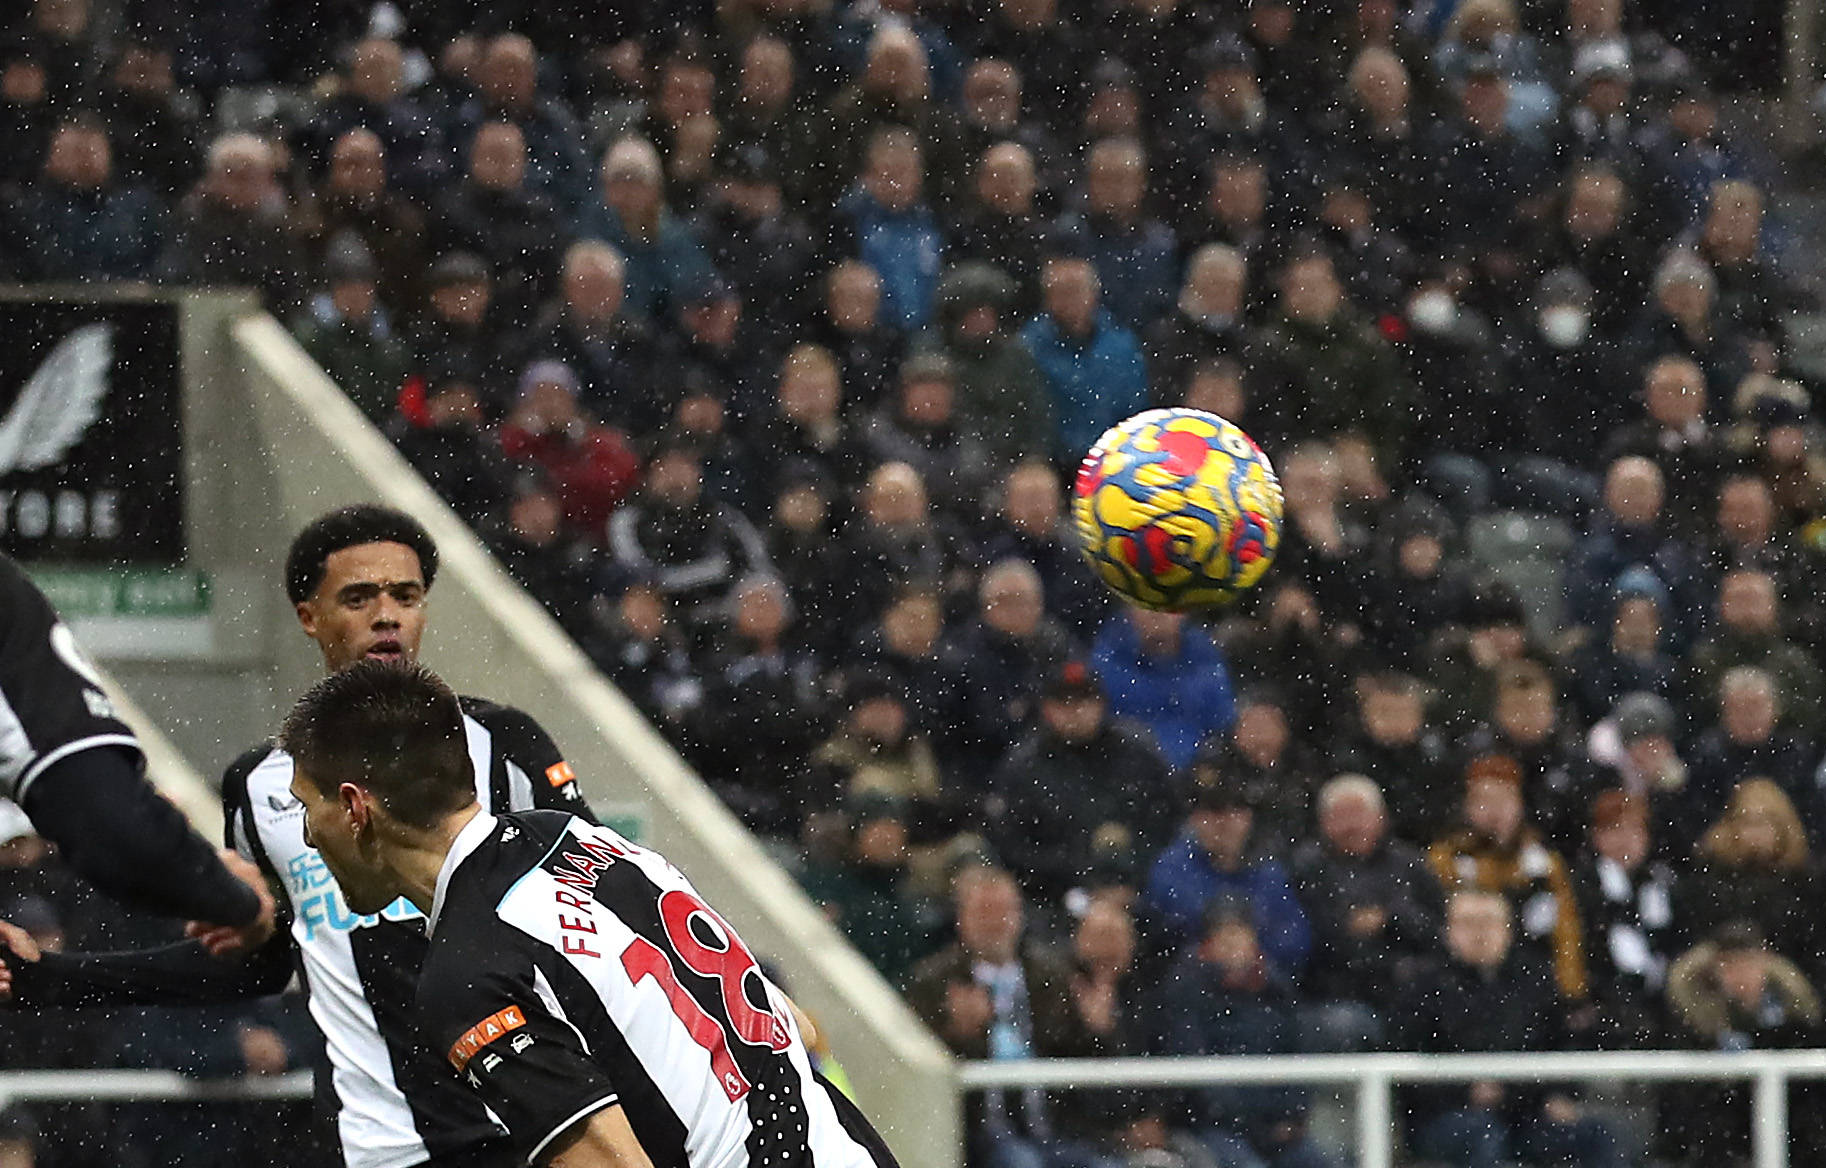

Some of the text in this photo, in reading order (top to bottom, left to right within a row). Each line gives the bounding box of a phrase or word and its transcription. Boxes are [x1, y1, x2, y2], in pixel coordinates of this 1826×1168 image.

[0, 487, 121, 539] ORE
[553, 834, 640, 959] FERNAN
[619, 889, 792, 1104] 18
